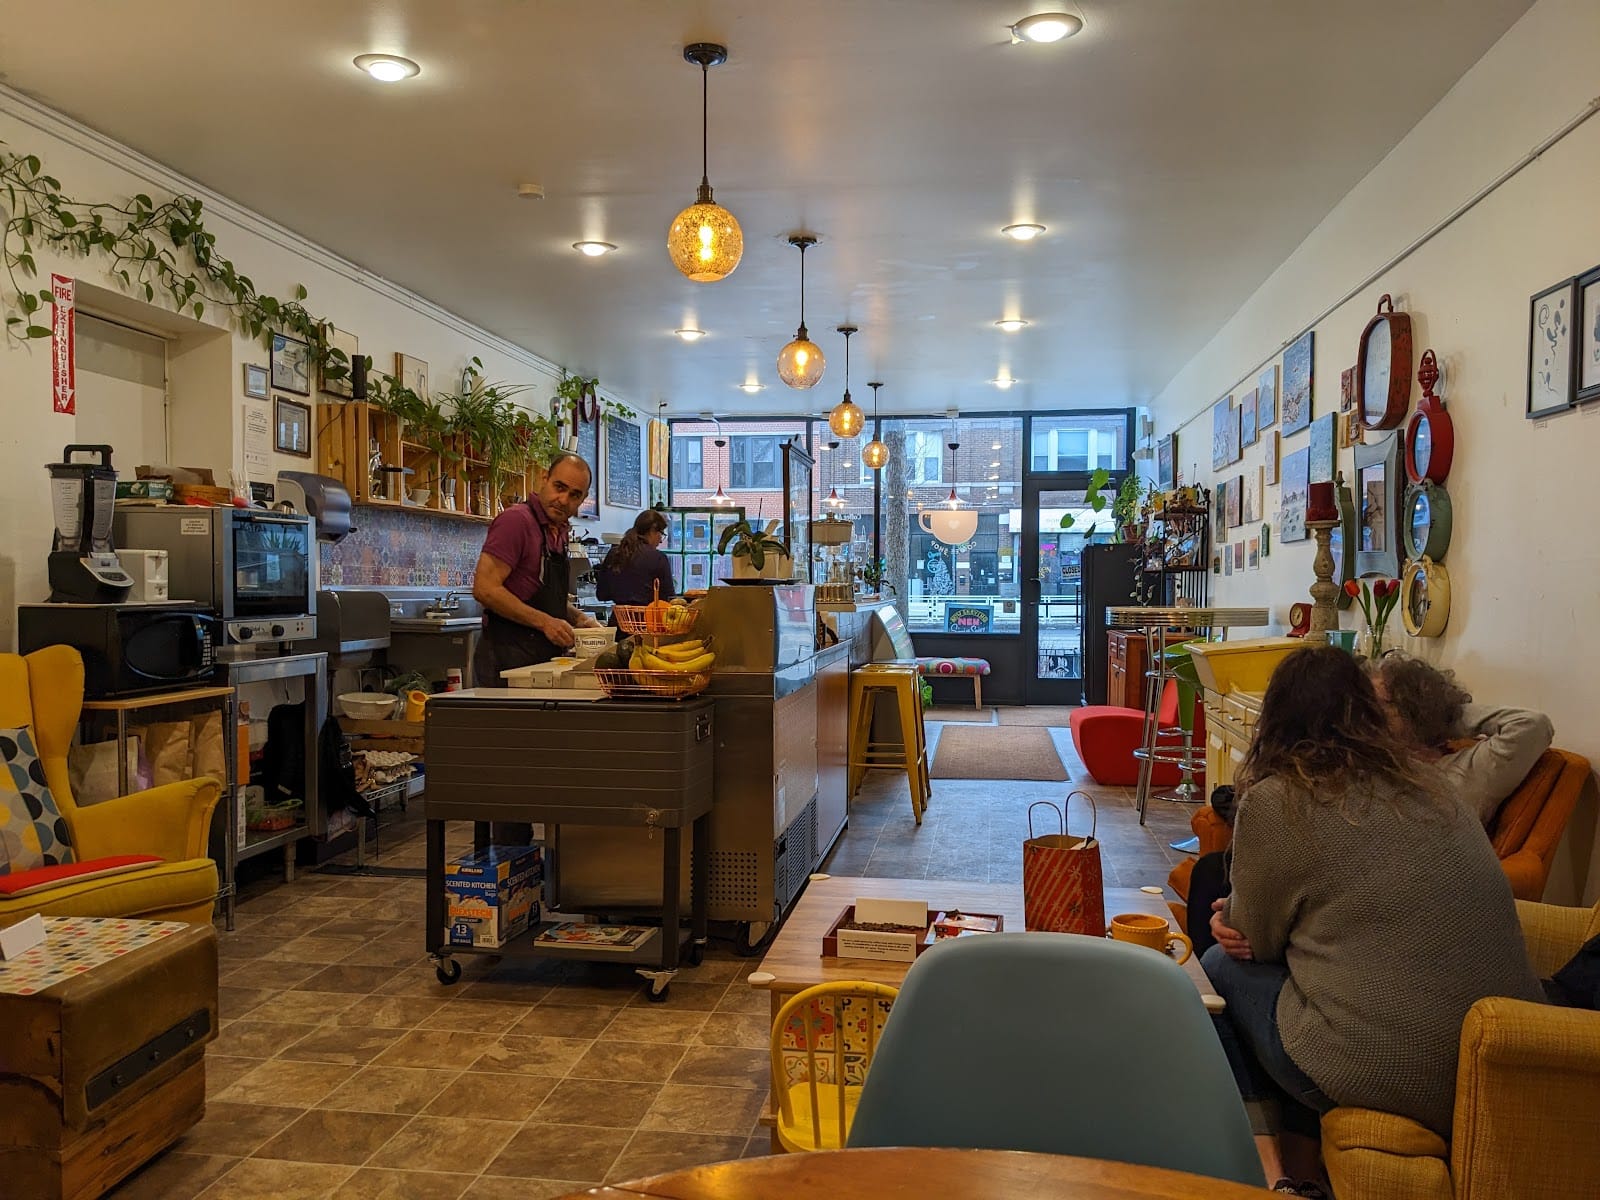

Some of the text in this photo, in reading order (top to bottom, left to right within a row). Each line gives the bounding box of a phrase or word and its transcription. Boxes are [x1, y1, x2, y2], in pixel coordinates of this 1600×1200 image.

[54, 286, 72, 301] FIRE
[60, 305, 68, 401] EXTINGUISHER
[446, 880, 470, 888] SCENTED
[456, 924, 467, 934] 13
